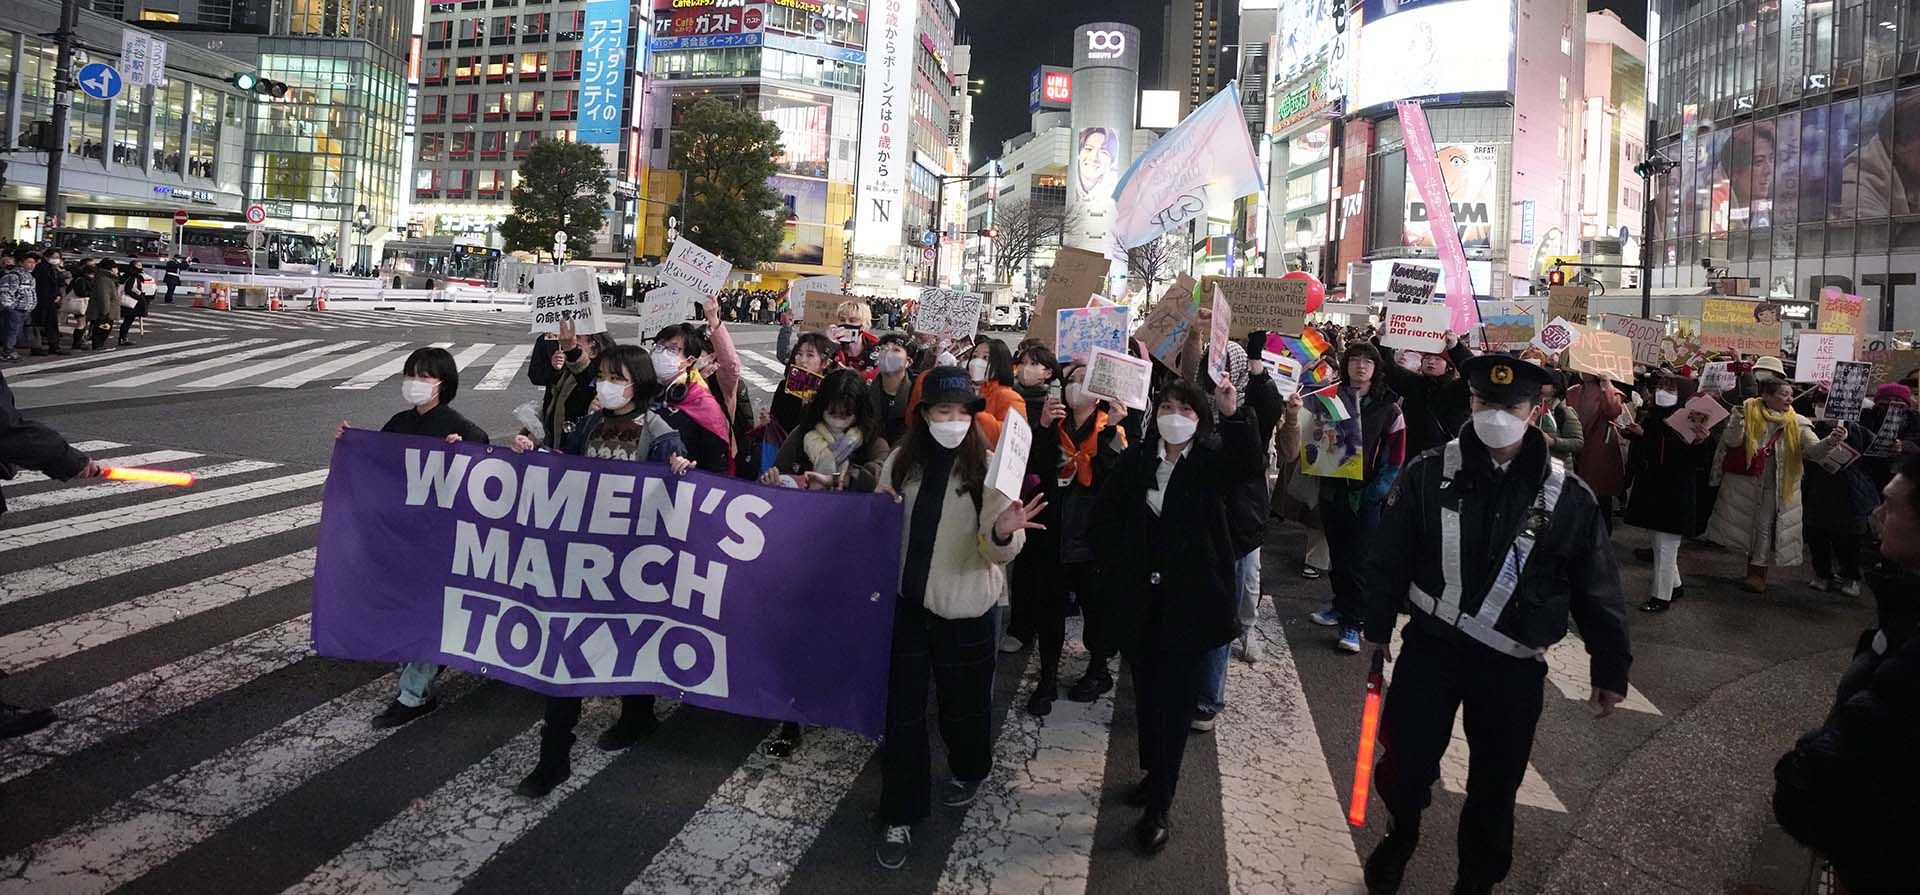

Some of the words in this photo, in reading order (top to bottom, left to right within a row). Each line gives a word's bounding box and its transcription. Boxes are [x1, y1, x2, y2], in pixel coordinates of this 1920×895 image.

[822, 3, 859, 22] ガスト
[656, 19, 672, 32] 7F
[675, 17, 694, 27] Café
[695, 14, 739, 34] ガスト
[681, 37, 742, 48] 英会話イーオン
[1086, 30, 1125, 58] 109
[583, 20, 608, 121] アイシティ
[602, 19, 623, 121] コンタクトの
[1047, 76, 1068, 87] UNI
[1046, 86, 1068, 99] QLO
[1221, 279, 1247, 291] JAPAN
[1250, 280, 1289, 292] RANKING
[1235, 291, 1248, 301] OF
[1265, 293, 1307, 305] COUNTRIES
[1231, 303, 1269, 315] GENDER
[1270, 305, 1306, 318] EQUALITY
[1239, 315, 1283, 328] DISGRACE
[1389, 320, 1407, 329] the
[1391, 313, 1424, 324] smash
[1618, 317, 1631, 329] MY
[1389, 327, 1446, 341] patriarchy
[1543, 326, 1569, 353] STOP
[1627, 322, 1664, 345] BODY
[1820, 337, 1835, 346] WE
[1631, 343, 1659, 365] ICE
[1816, 346, 1834, 355] ARE
[1817, 363, 1832, 372] THE
[404, 448, 773, 562] WOMEN'S
[451, 520, 728, 620] MARCH
[459, 593, 716, 688] TOKYO
